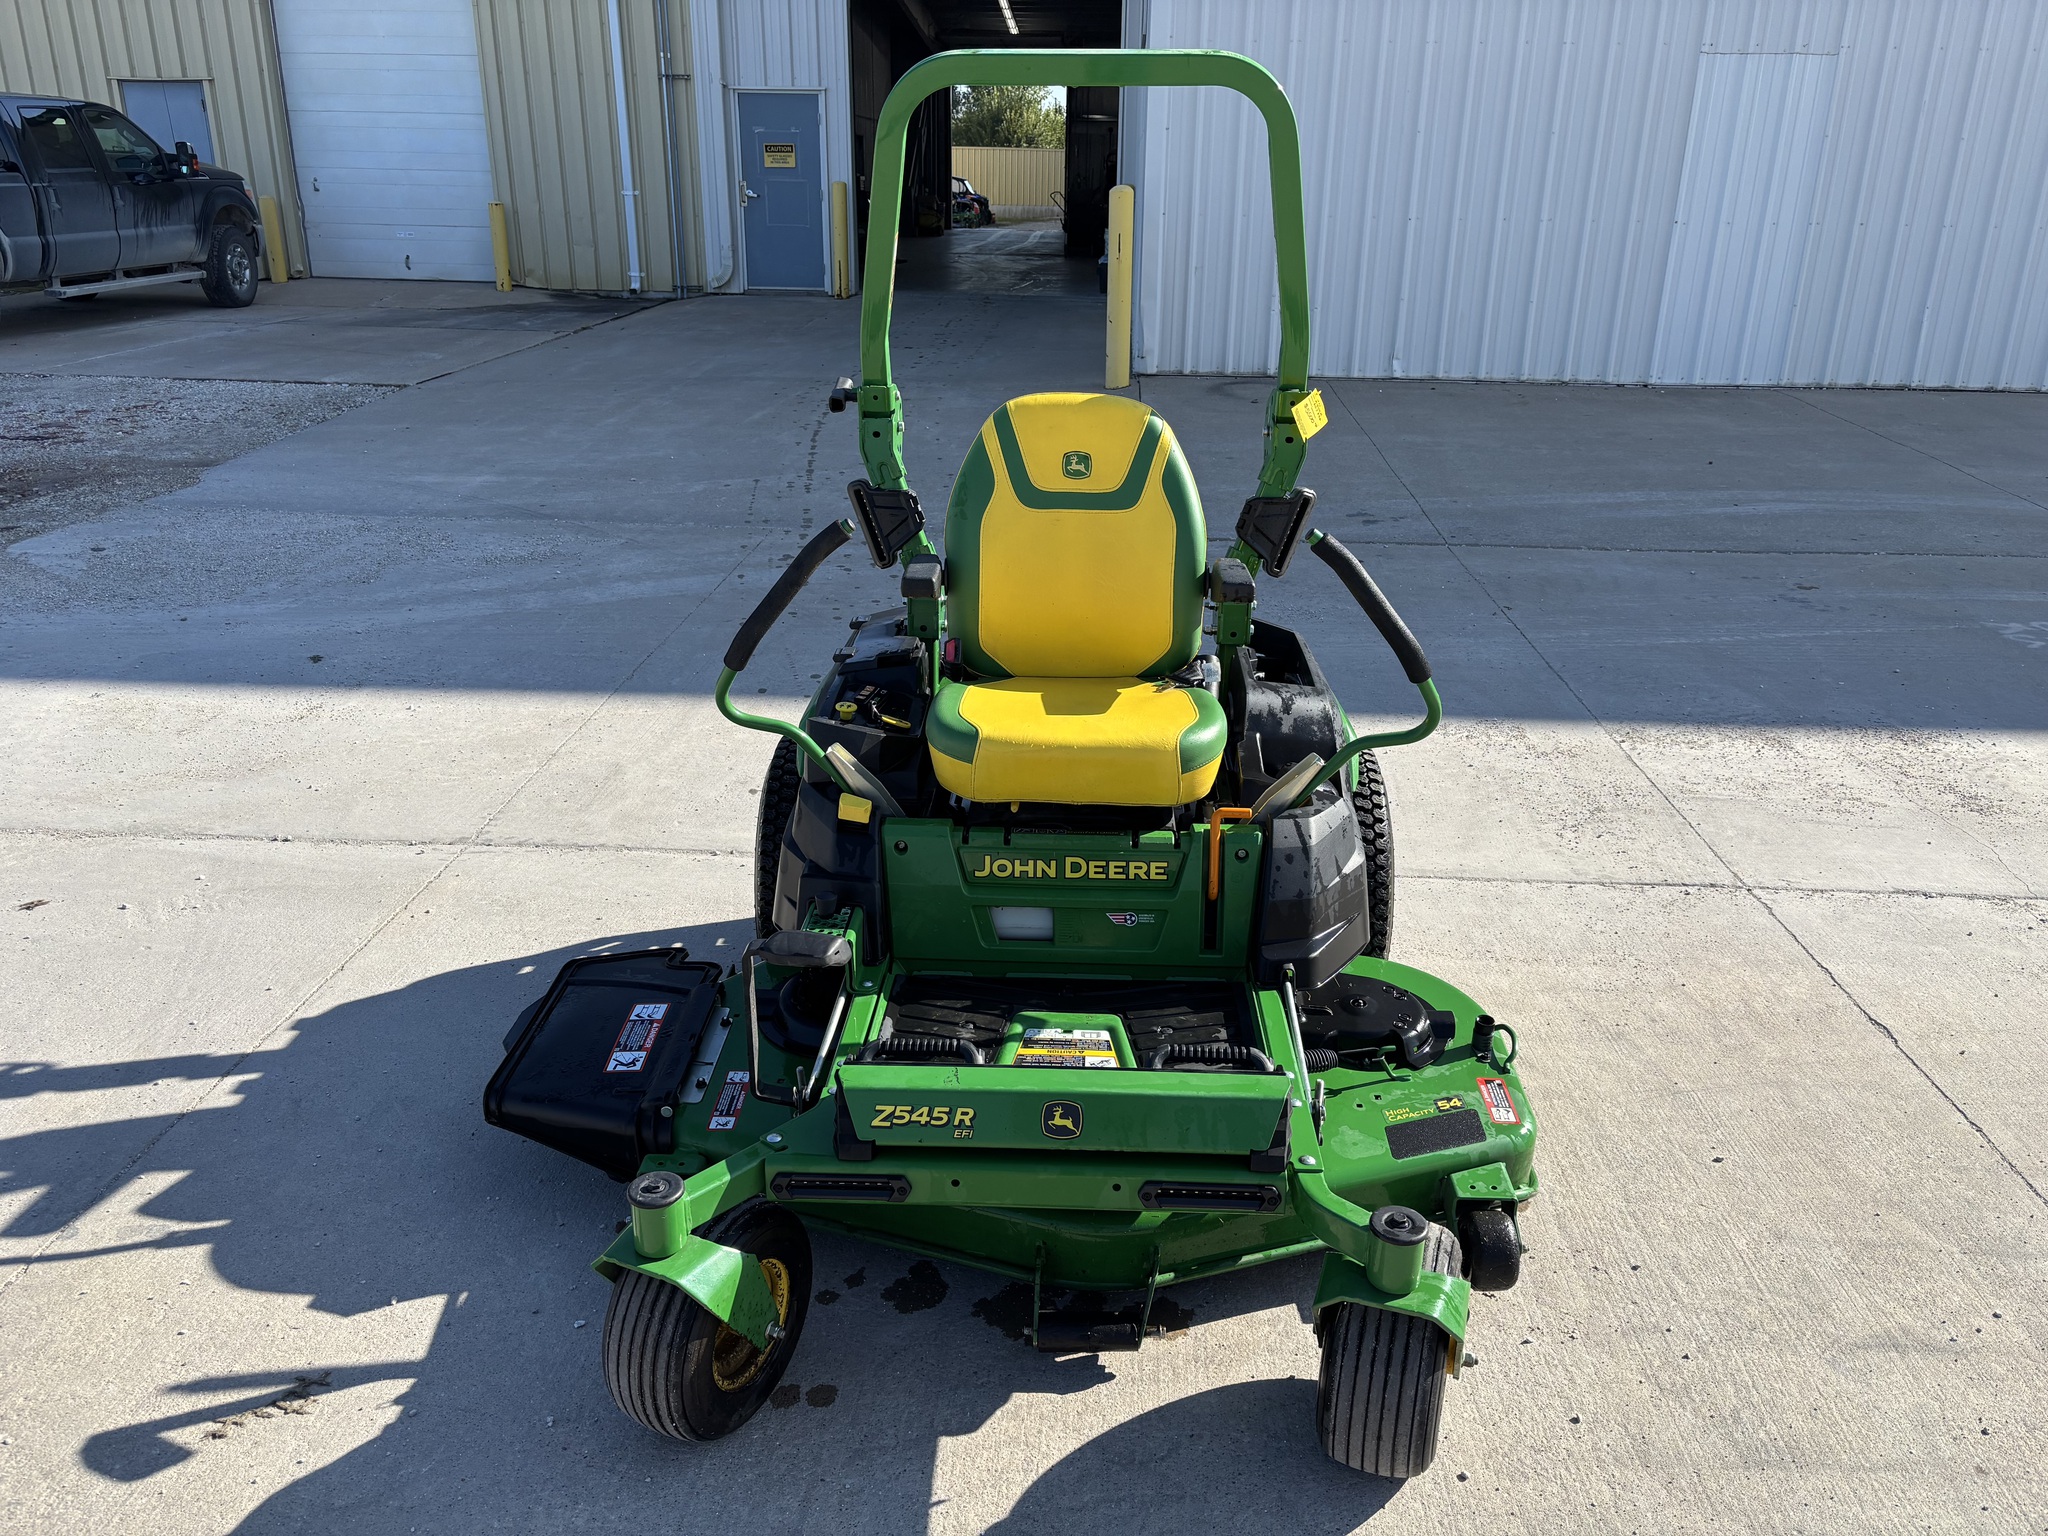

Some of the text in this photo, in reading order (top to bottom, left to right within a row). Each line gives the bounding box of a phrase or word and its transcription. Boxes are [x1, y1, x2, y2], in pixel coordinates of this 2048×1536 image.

[974, 854, 1169, 881] JOHN DEERE
[644, 1027, 659, 1048] DANGER
[1385, 1097, 1463, 1117] HIGH 54
[1388, 1108, 1435, 1122] CAPACITY
[954, 1129, 974, 1138] EFI
